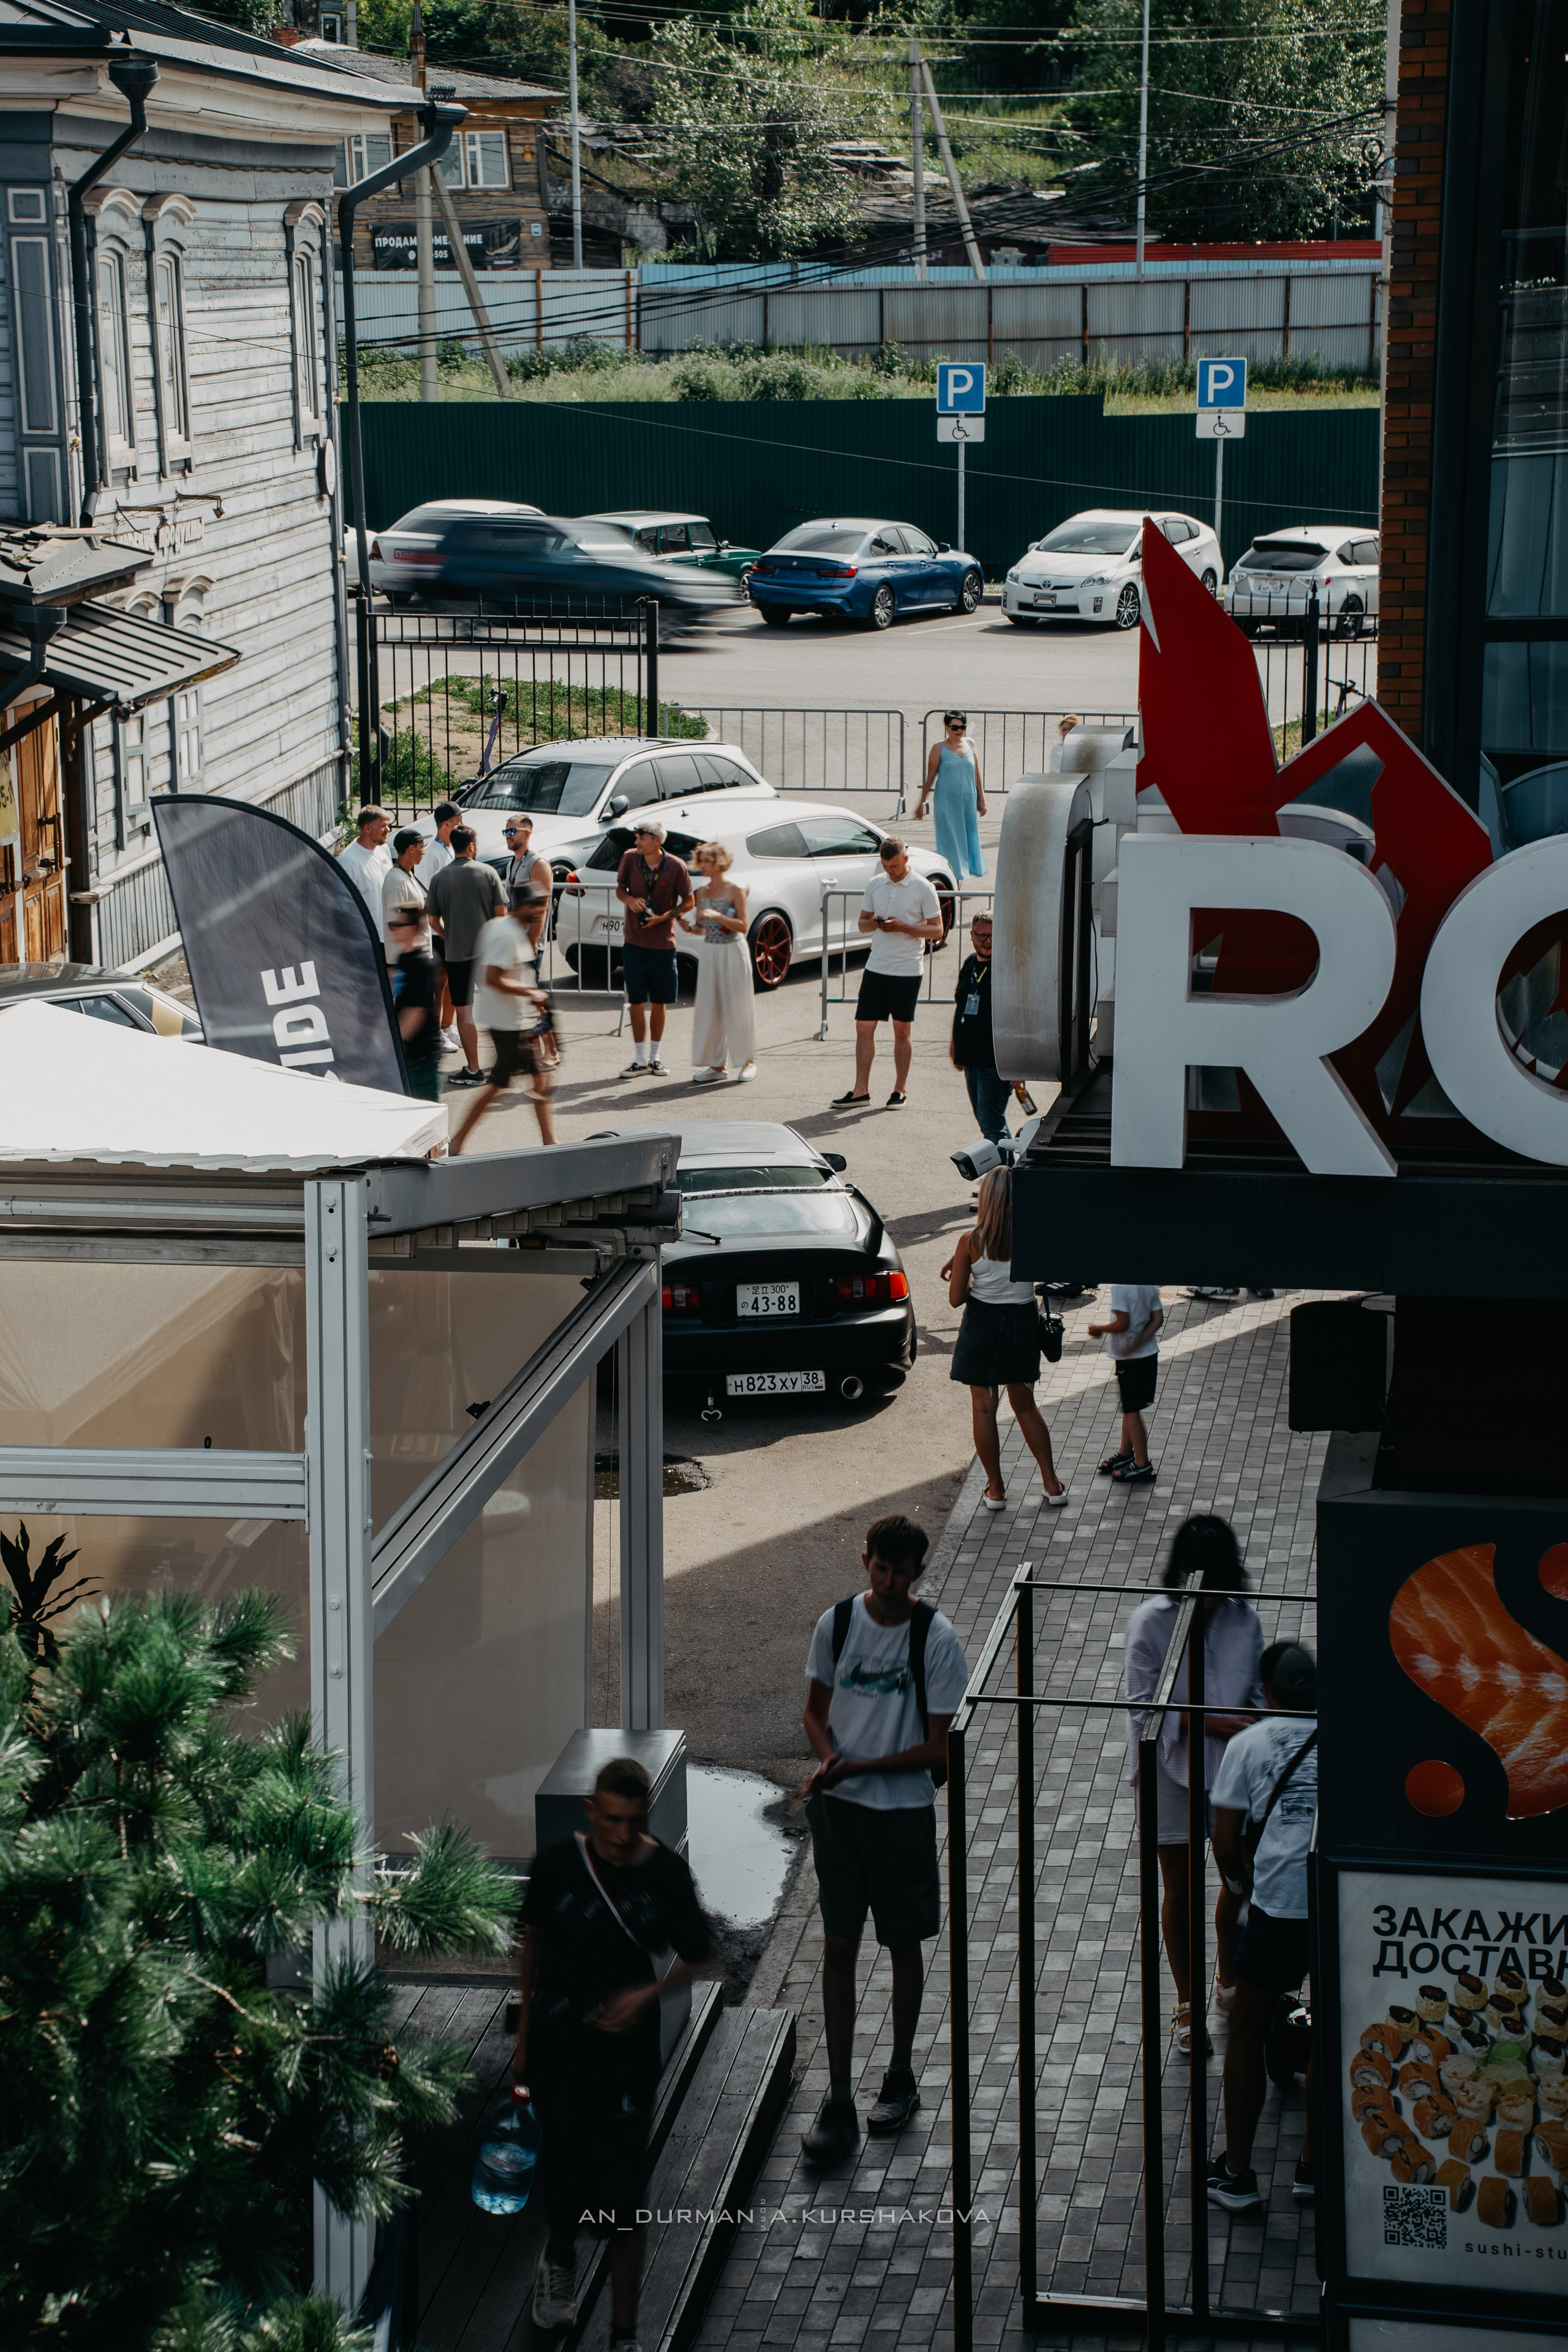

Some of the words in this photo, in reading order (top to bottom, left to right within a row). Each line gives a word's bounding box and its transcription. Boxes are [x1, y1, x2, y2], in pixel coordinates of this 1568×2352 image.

[375, 236, 417, 248] ПРОДАМ
[948, 369, 973, 407] P
[1207, 364, 1234, 403] P
[602, 920, 625, 932] Н90
[260, 960, 340, 1082] IDE
[752, 1286, 769, 1295] 足立
[771, 1285, 786, 1294] 300
[751, 1295, 796, 1313] 43-88
[803, 1372, 819, 1384] 38
[1465, 2242, 1567, 2260] sushi-stu
